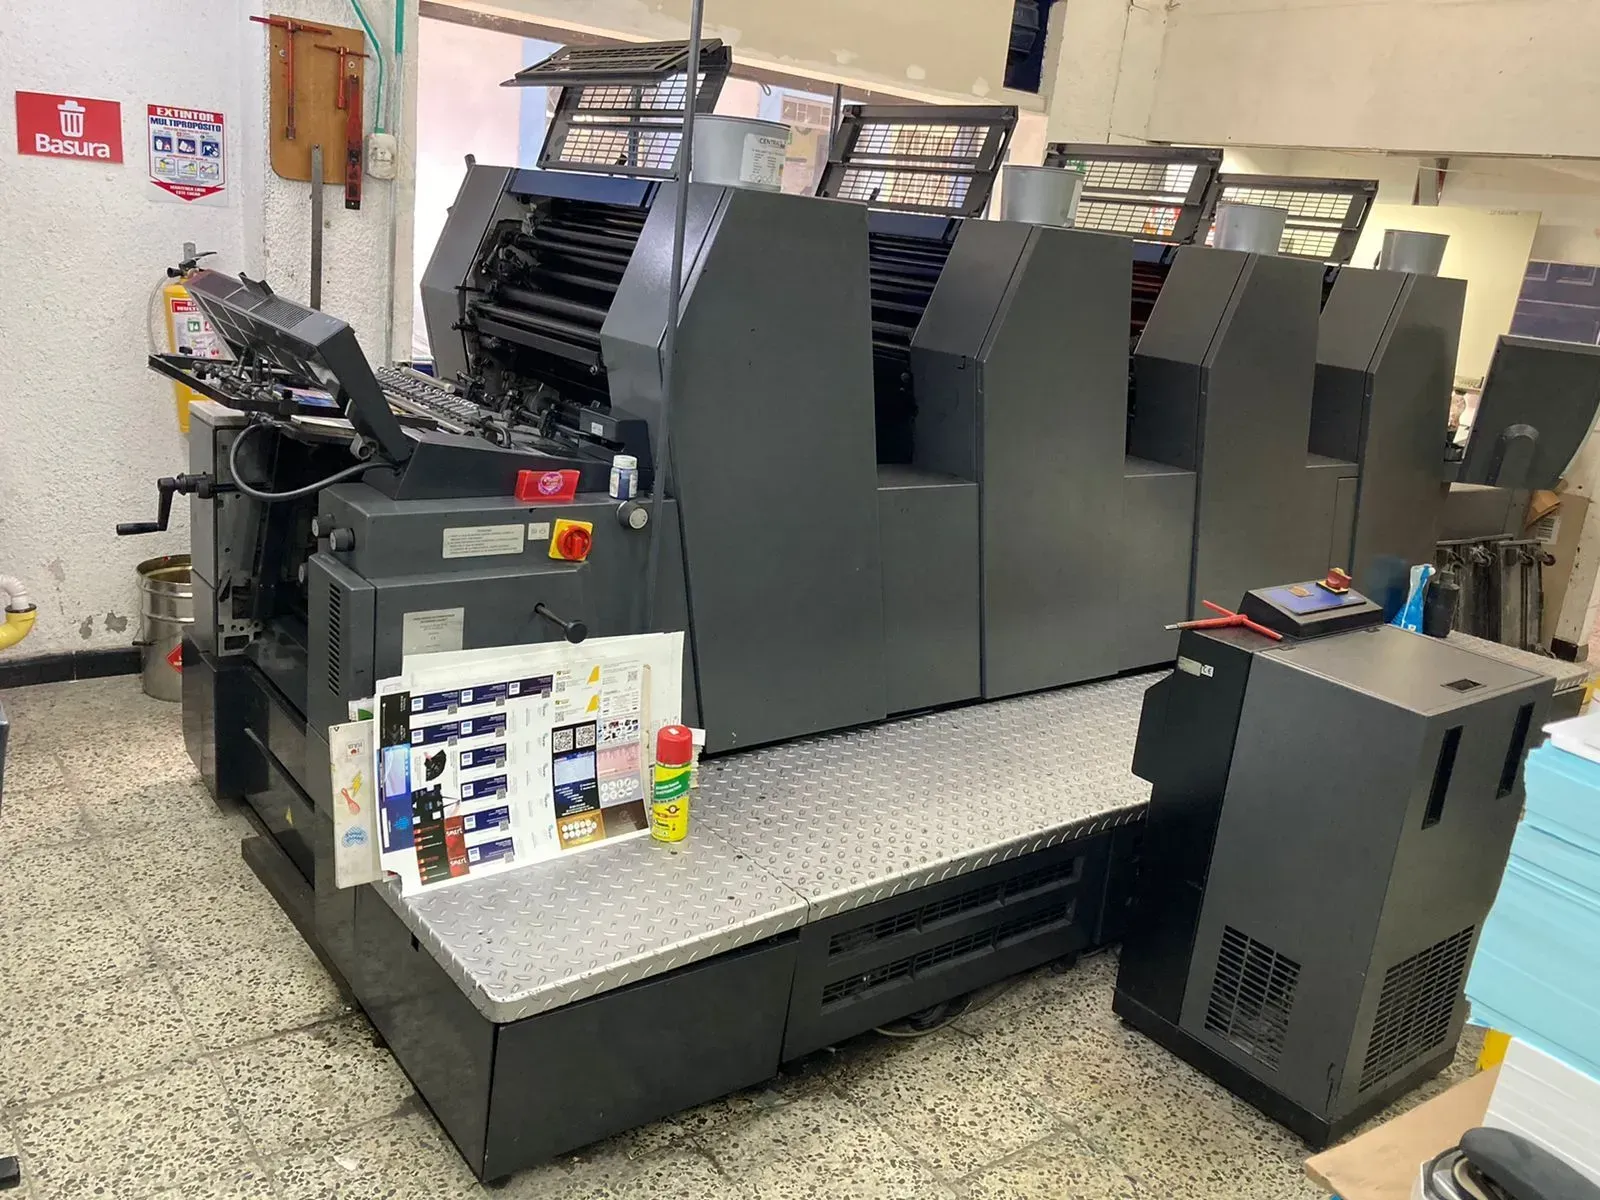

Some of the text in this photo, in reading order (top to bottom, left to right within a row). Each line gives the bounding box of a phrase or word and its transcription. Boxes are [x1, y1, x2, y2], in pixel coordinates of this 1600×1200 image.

[156, 107, 214, 122] EXTINTOR
[35, 133, 110, 158] Basura
[1203, 666, 1212, 675] CE
